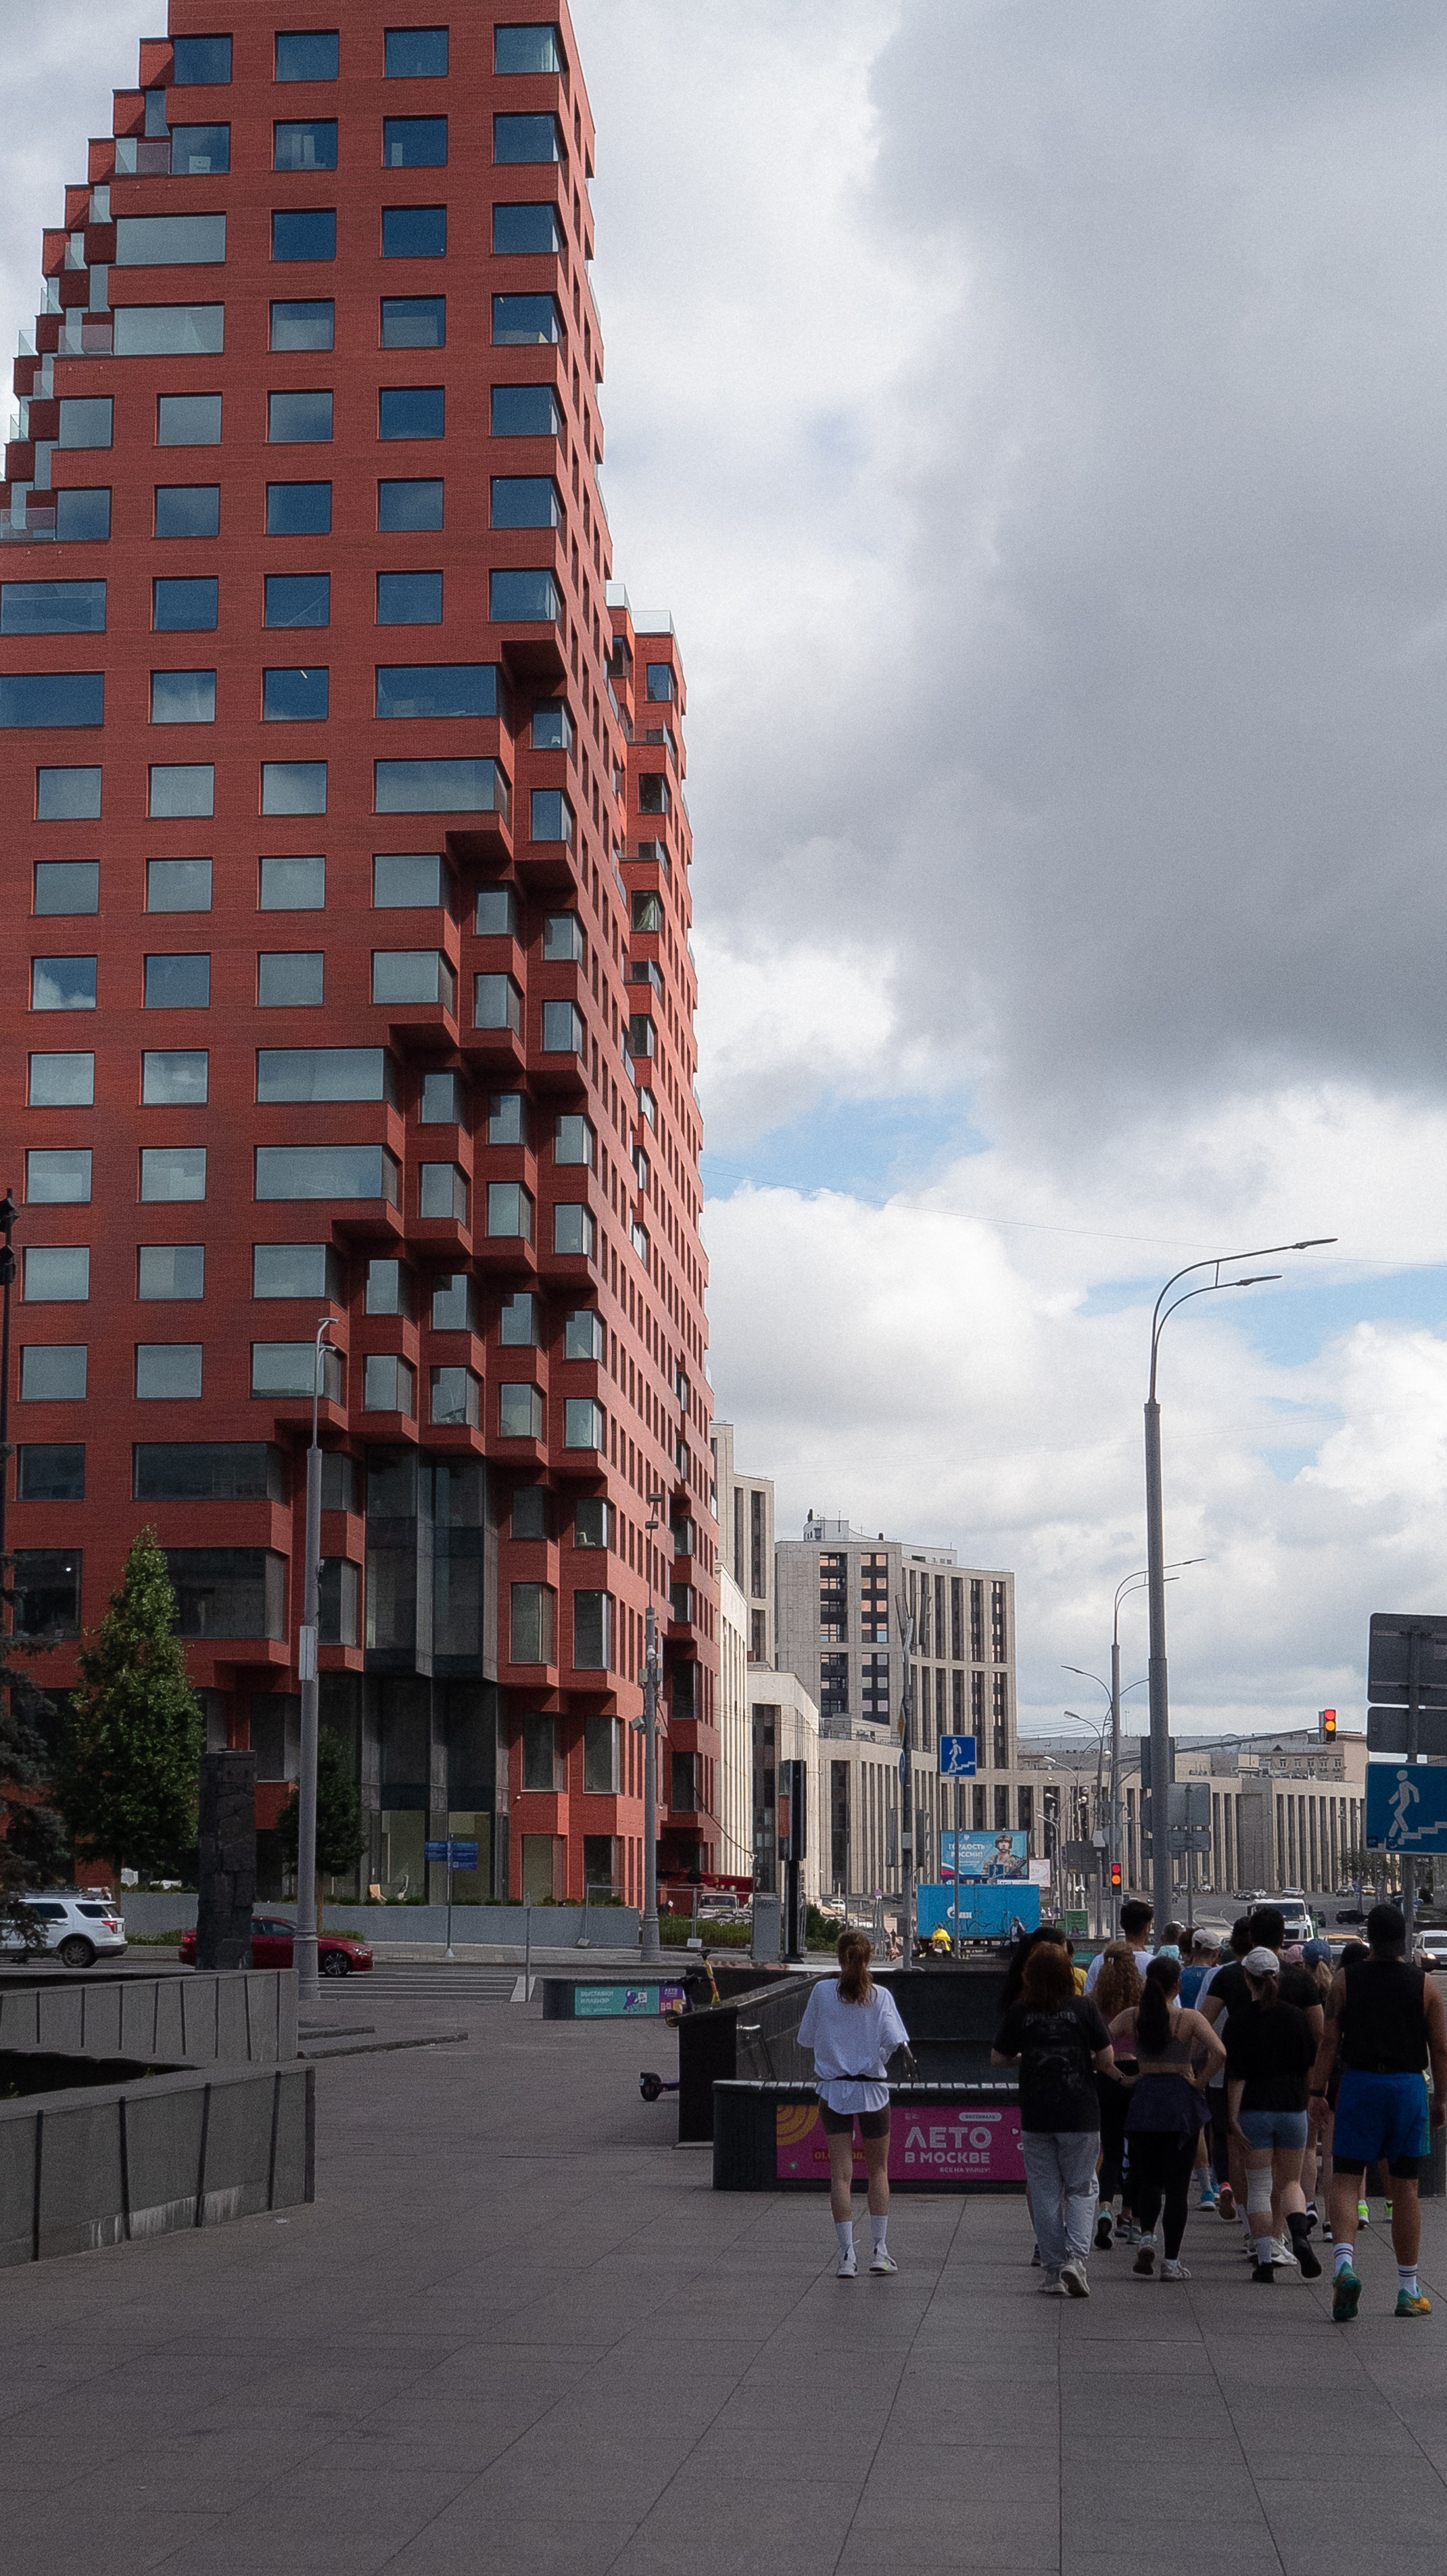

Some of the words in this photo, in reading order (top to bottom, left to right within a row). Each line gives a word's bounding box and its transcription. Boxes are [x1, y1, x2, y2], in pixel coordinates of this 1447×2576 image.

[904, 2126, 992, 2149] ЛЕТО
[905, 2152, 916, 2163] В
[920, 2151, 990, 2163] МОСКВЕ
